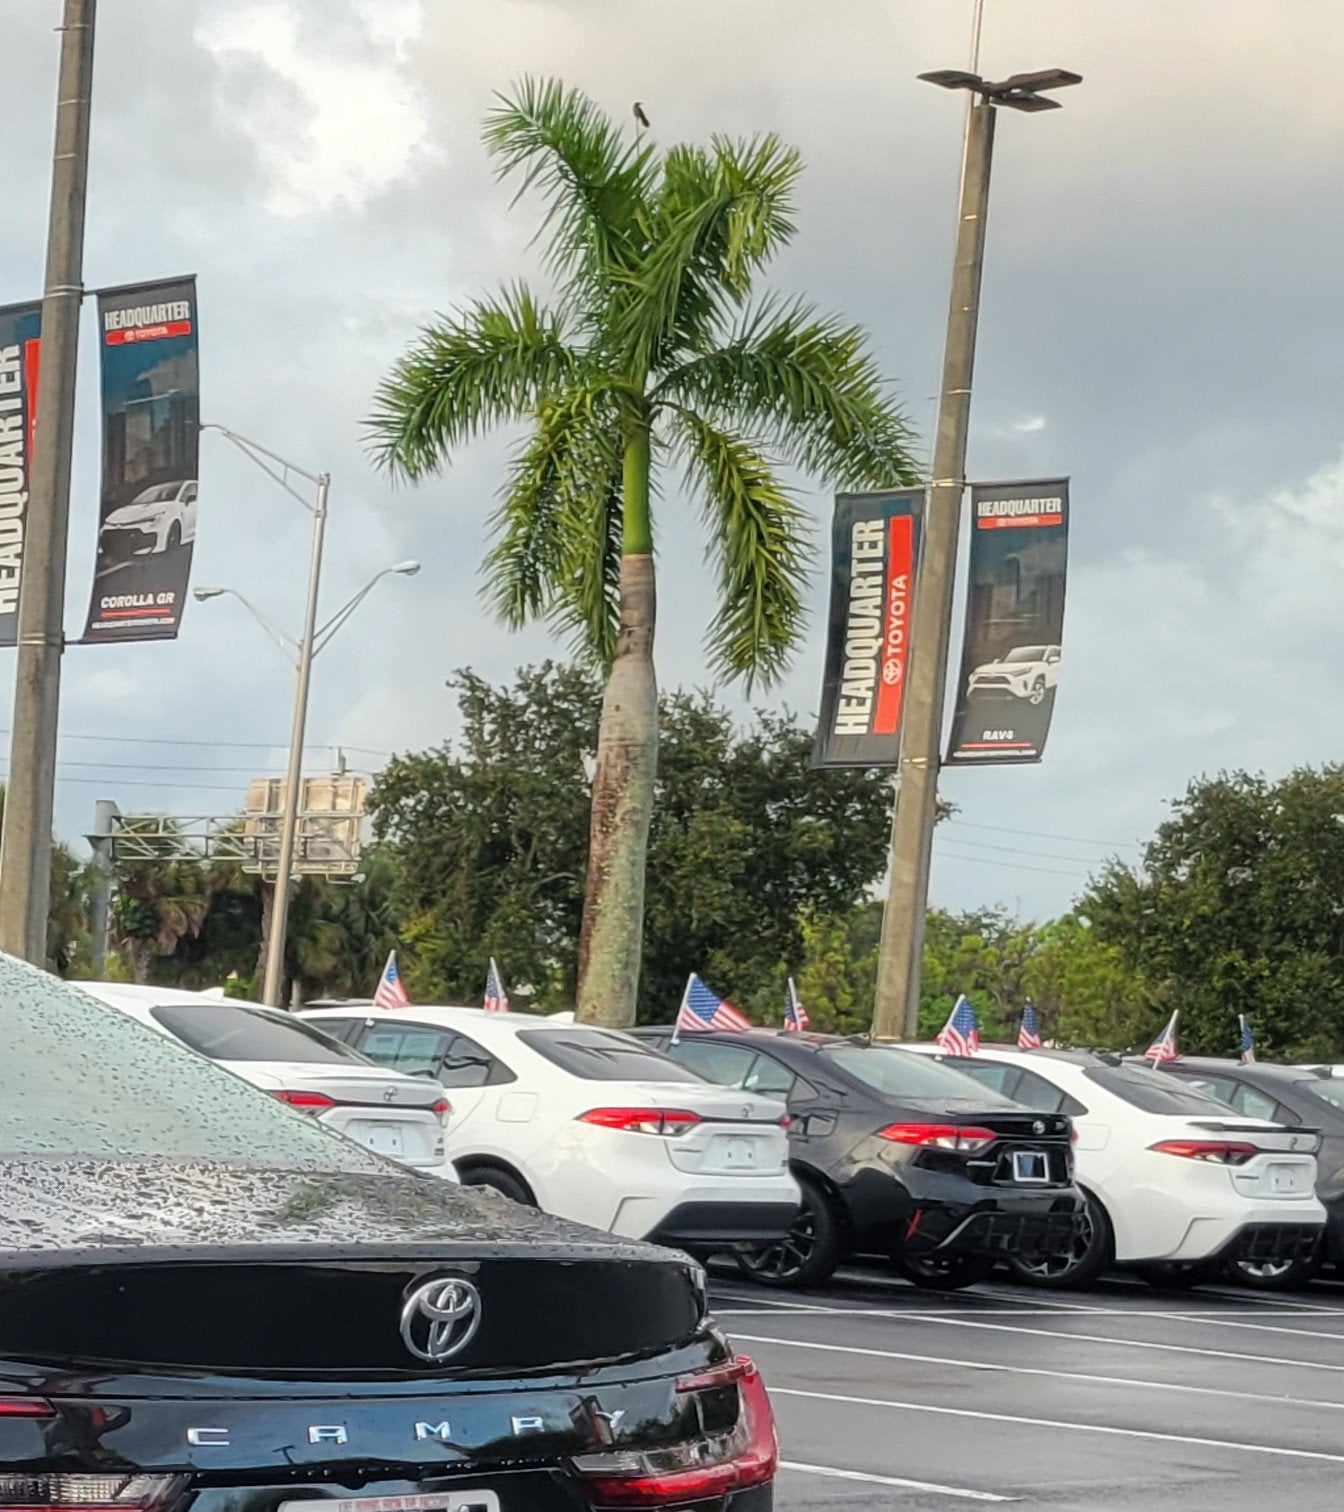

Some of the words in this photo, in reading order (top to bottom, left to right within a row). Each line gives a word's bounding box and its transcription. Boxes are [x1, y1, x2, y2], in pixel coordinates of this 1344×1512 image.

[105, 301, 190, 331] HEADQUARTER
[976, 498, 1062, 516] HEADQUARTER
[101, 593, 154, 608] COROLLA
[156, 592, 175, 604] GR
[834, 519, 885, 735] HEADQUARTER
[887, 574, 908, 656] TOYOTA
[983, 730, 1014, 740] RAV4
